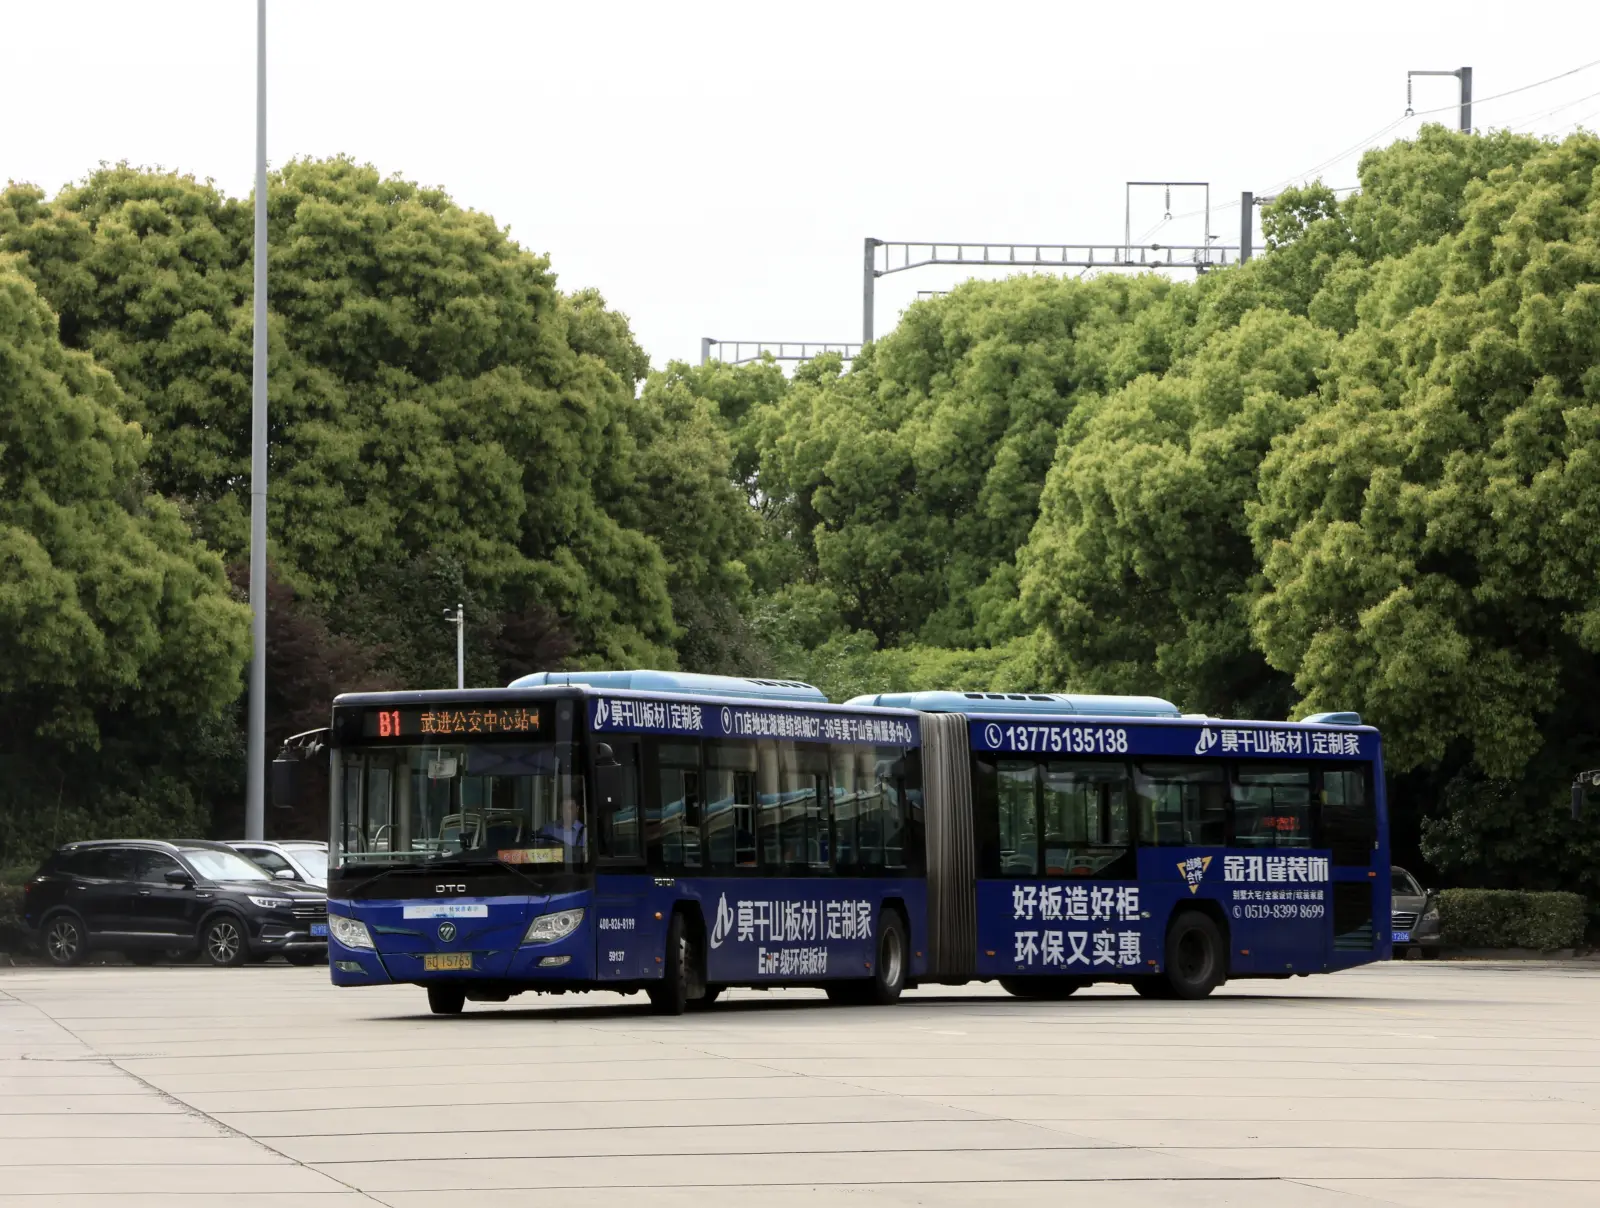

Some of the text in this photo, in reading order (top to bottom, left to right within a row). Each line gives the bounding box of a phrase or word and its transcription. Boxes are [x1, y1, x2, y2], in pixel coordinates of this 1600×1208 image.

[379, 711, 400, 736] B1
[420, 709, 530, 733] 武进公交中心站
[1006, 726, 1128, 753] 13775135138
[1186, 870, 1203, 885] 合作
[1223, 855, 1329, 882] 金孔雀装饰
[1012, 885, 1140, 921] 好板造好柜
[1013, 930, 1142, 966] 环保又实惠
